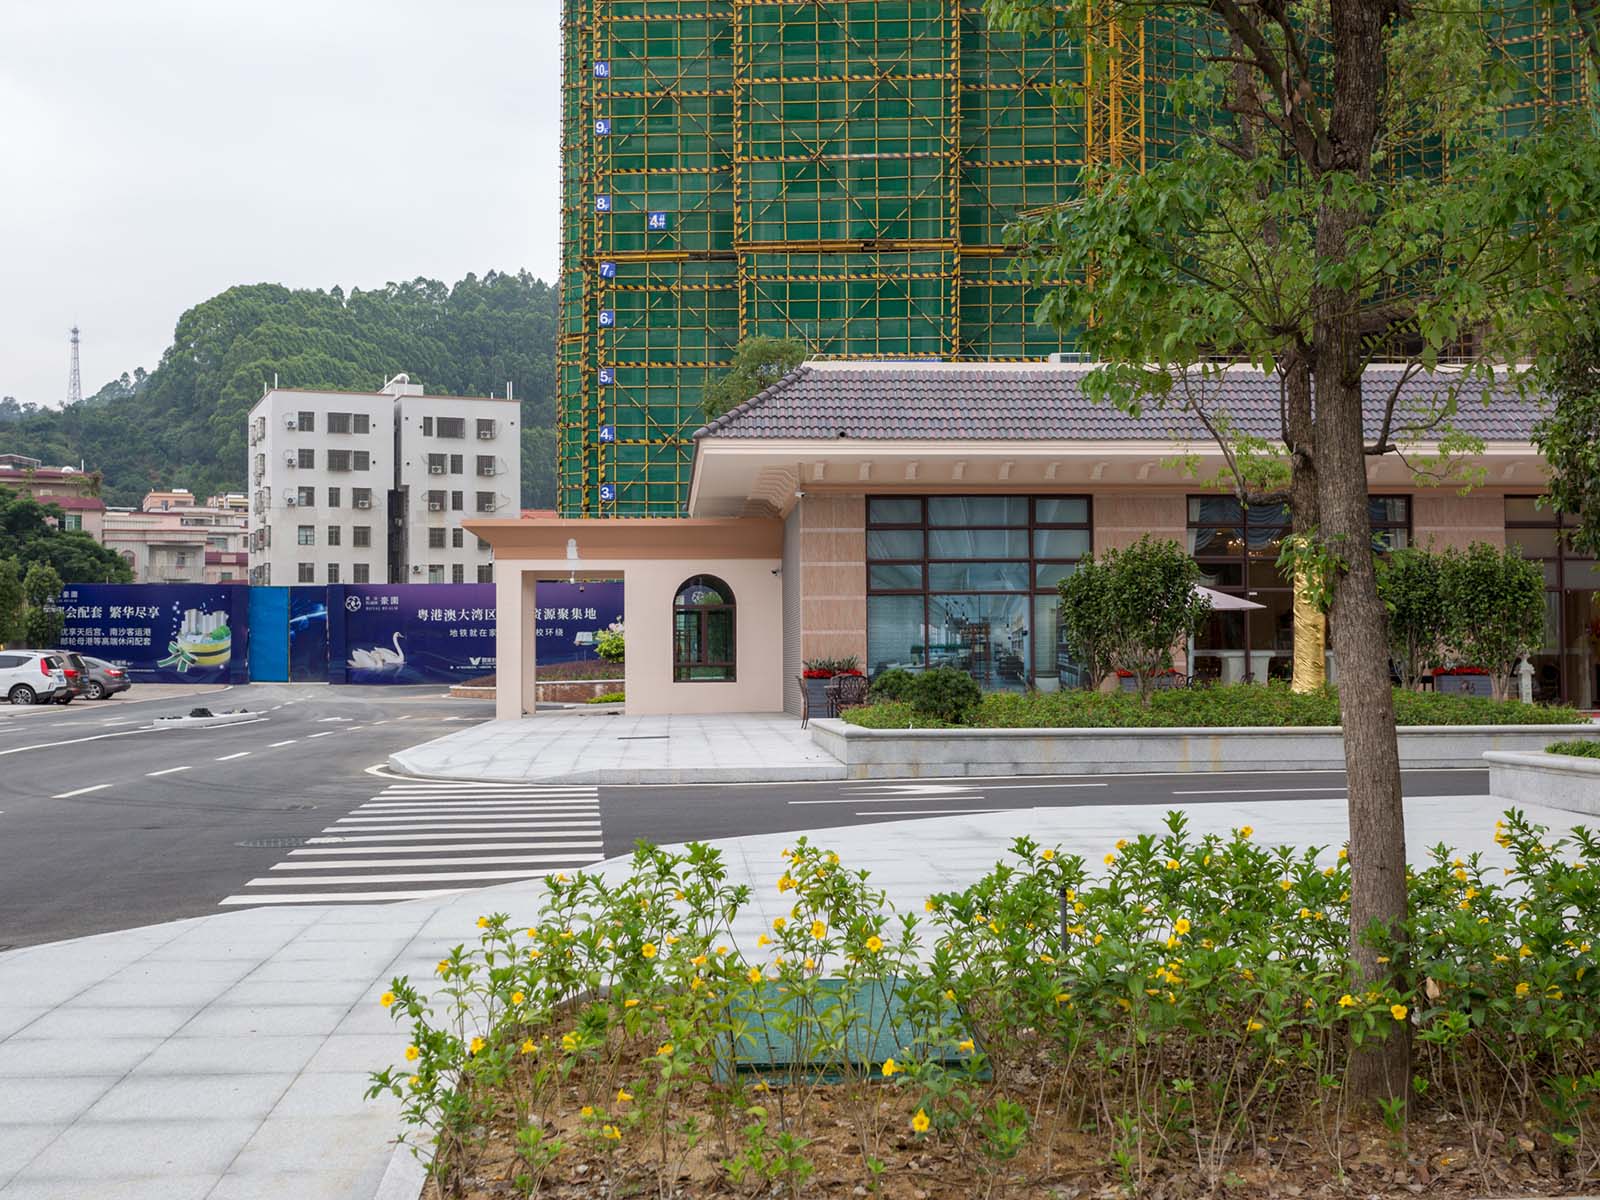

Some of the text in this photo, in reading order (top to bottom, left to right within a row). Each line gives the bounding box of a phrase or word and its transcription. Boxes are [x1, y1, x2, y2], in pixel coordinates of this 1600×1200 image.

[595, 63, 609, 77] 10F
[595, 121, 609, 134] 9F
[596, 198, 609, 210] 8F
[600, 264, 614, 277] 7F
[599, 312, 612, 325] 6F
[599, 371, 612, 384] 5F
[600, 428, 614, 441] 4F
[600, 487, 614, 500] 3F
[109, 606, 160, 619] 繁华尽享
[417, 608, 497, 622] 粤港澳大湾区
